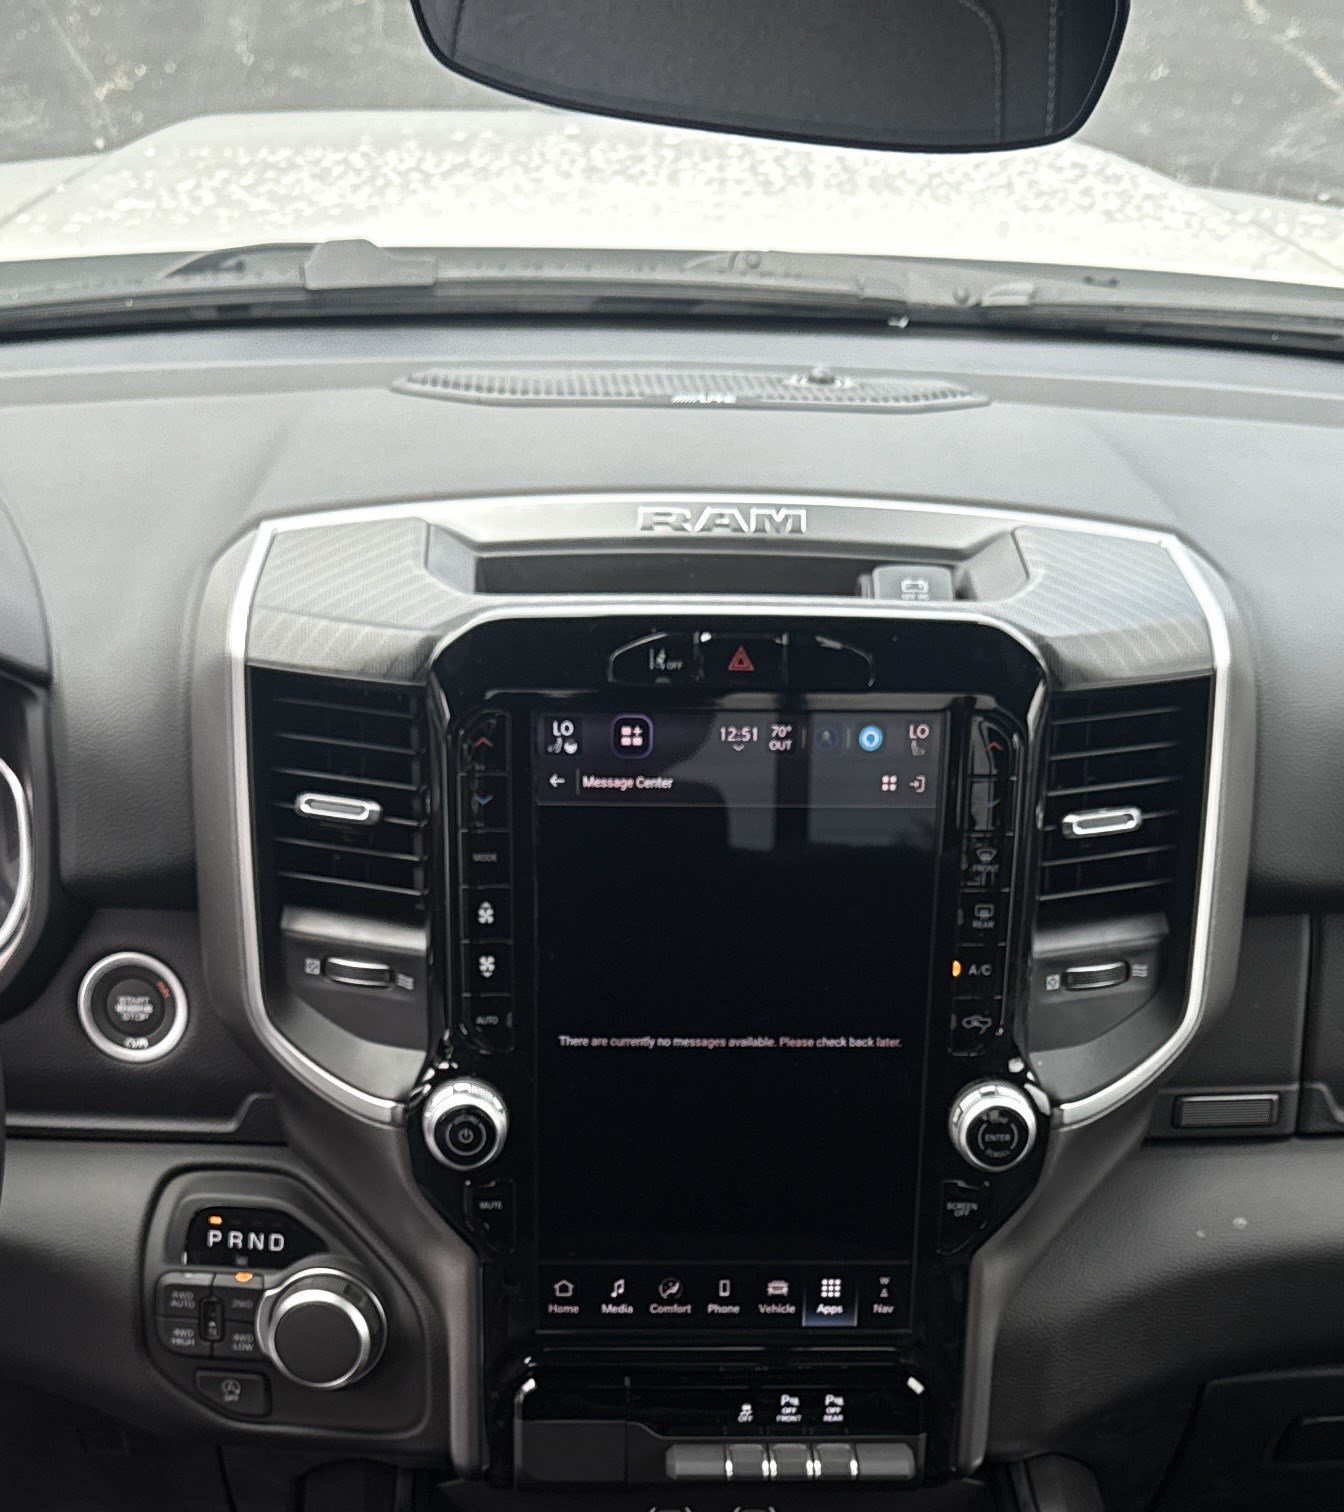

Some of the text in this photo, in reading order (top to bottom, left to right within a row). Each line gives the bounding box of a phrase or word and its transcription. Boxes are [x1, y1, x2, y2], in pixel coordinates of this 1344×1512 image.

[636, 506, 807, 533] RAM
[552, 719, 575, 737] LO
[719, 725, 758, 743] 12:51
[909, 723, 930, 740] LO
[768, 739, 793, 752] OUT
[581, 774, 675, 792] Message Center
[968, 963, 993, 977] A/C
[558, 1034, 590, 1047] There
[591, 1037, 608, 1047] are
[609, 1036, 656, 1050] currently
[657, 1037, 671, 1047] no
[672, 1037, 727, 1050] messages
[779, 1036, 814, 1048] Please
[816, 1036, 847, 1048] check
[848, 1036, 874, 1048] back
[547, 1303, 581, 1315] Home
[600, 1303, 634, 1315] Media
[649, 1303, 692, 1315] Comfort
[707, 1303, 741, 1315] Phone
[758, 1303, 797, 1315] Vehicle
[816, 1303, 844, 1317] Apps
[872, 1303, 895, 1315] Nav
